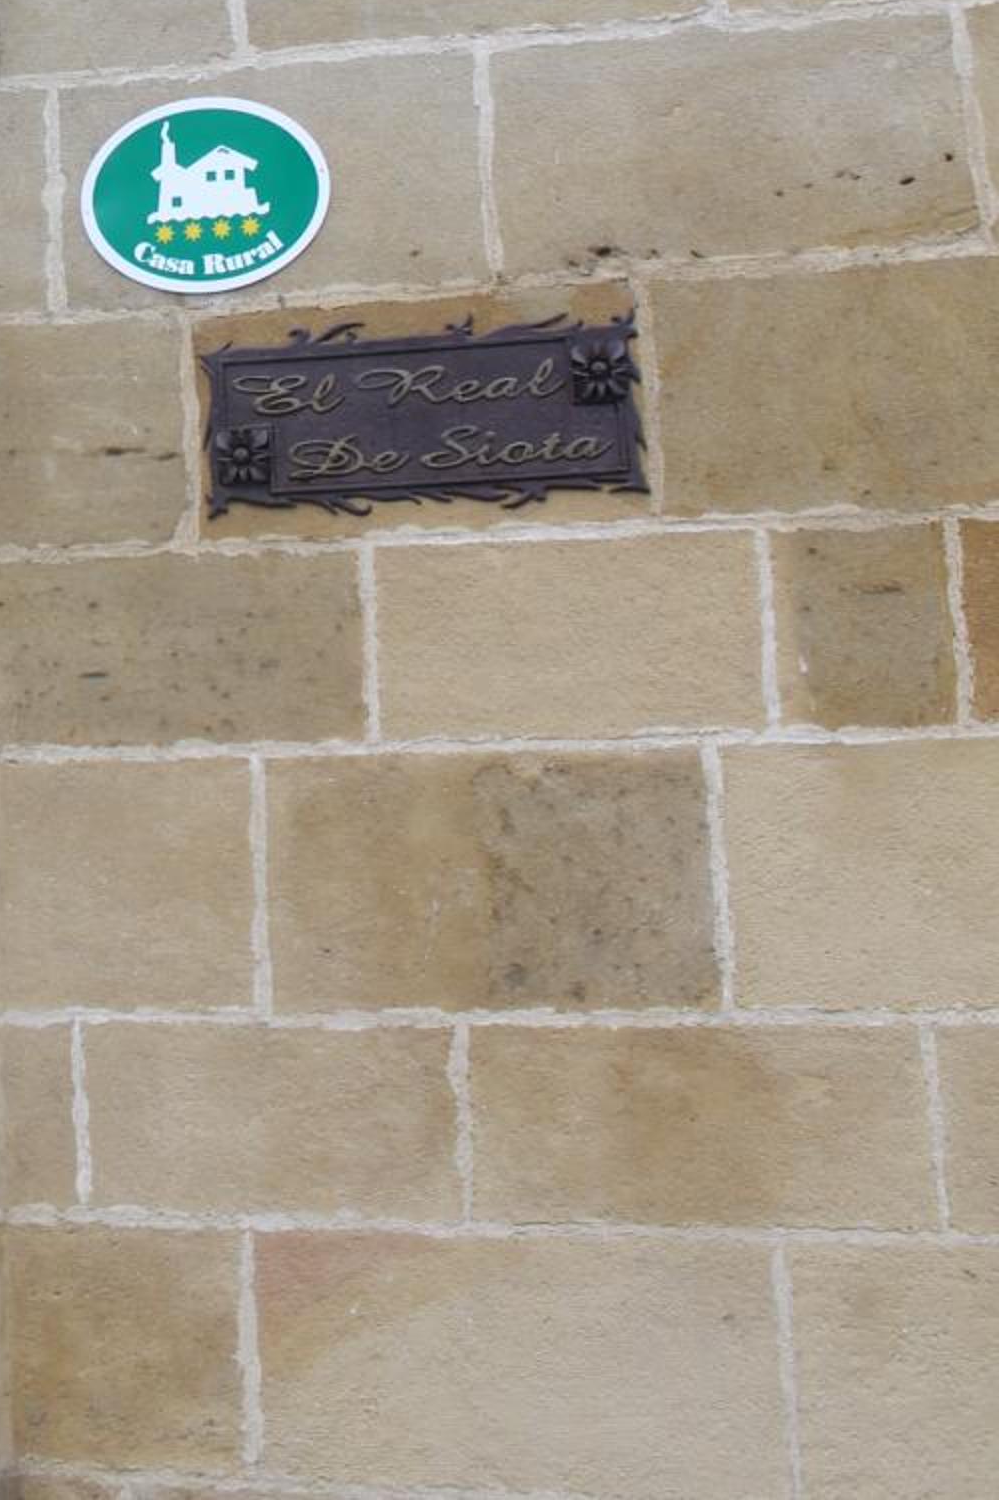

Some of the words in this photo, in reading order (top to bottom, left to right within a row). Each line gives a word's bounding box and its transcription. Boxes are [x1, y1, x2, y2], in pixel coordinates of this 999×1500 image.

[134, 242, 195, 275] Casa
[203, 230, 284, 275] Rural
[232, 373, 344, 415] El
[357, 358, 565, 405] Real
[289, 435, 407, 480] De
